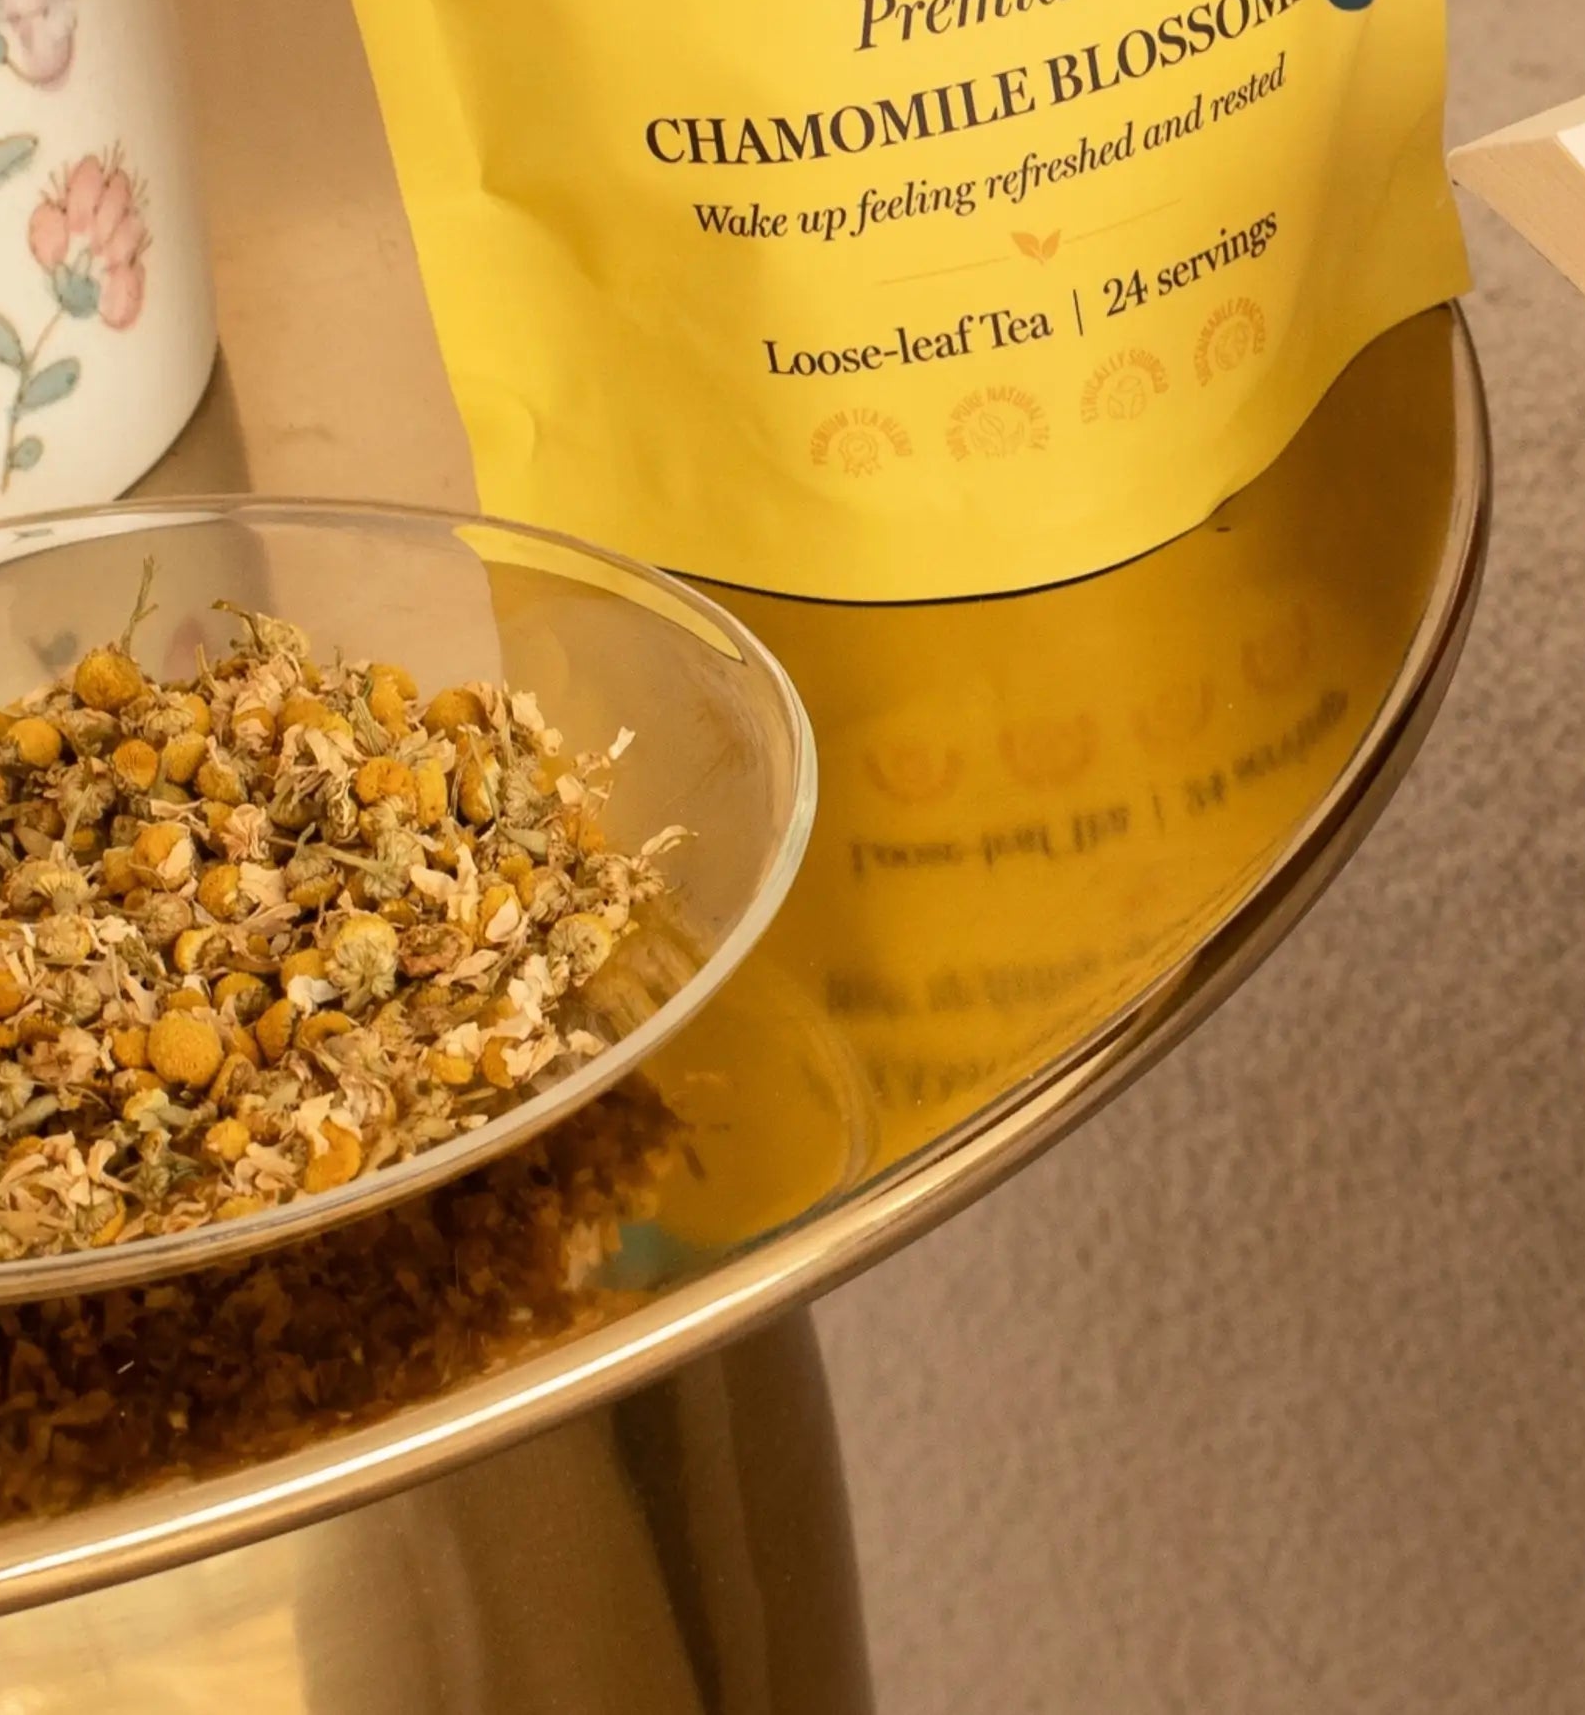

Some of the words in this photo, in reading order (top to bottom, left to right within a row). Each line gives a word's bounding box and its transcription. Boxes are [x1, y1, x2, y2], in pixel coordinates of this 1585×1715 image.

[645, 65, 1036, 166] CHAMOMILE
[692, 202, 789, 239] Wake
[796, 206, 848, 242] up
[848, 179, 977, 239] feeling
[984, 122, 1136, 200] refreshed
[1142, 92, 1205, 151] and
[1209, 50, 1286, 123] rested
[1102, 268, 1149, 318] 24
[1156, 211, 1278, 297] servings
[761, 314, 975, 377] Loose-leaf
[978, 309, 1055, 350] Tea
[852, 407, 879, 427] TEA
